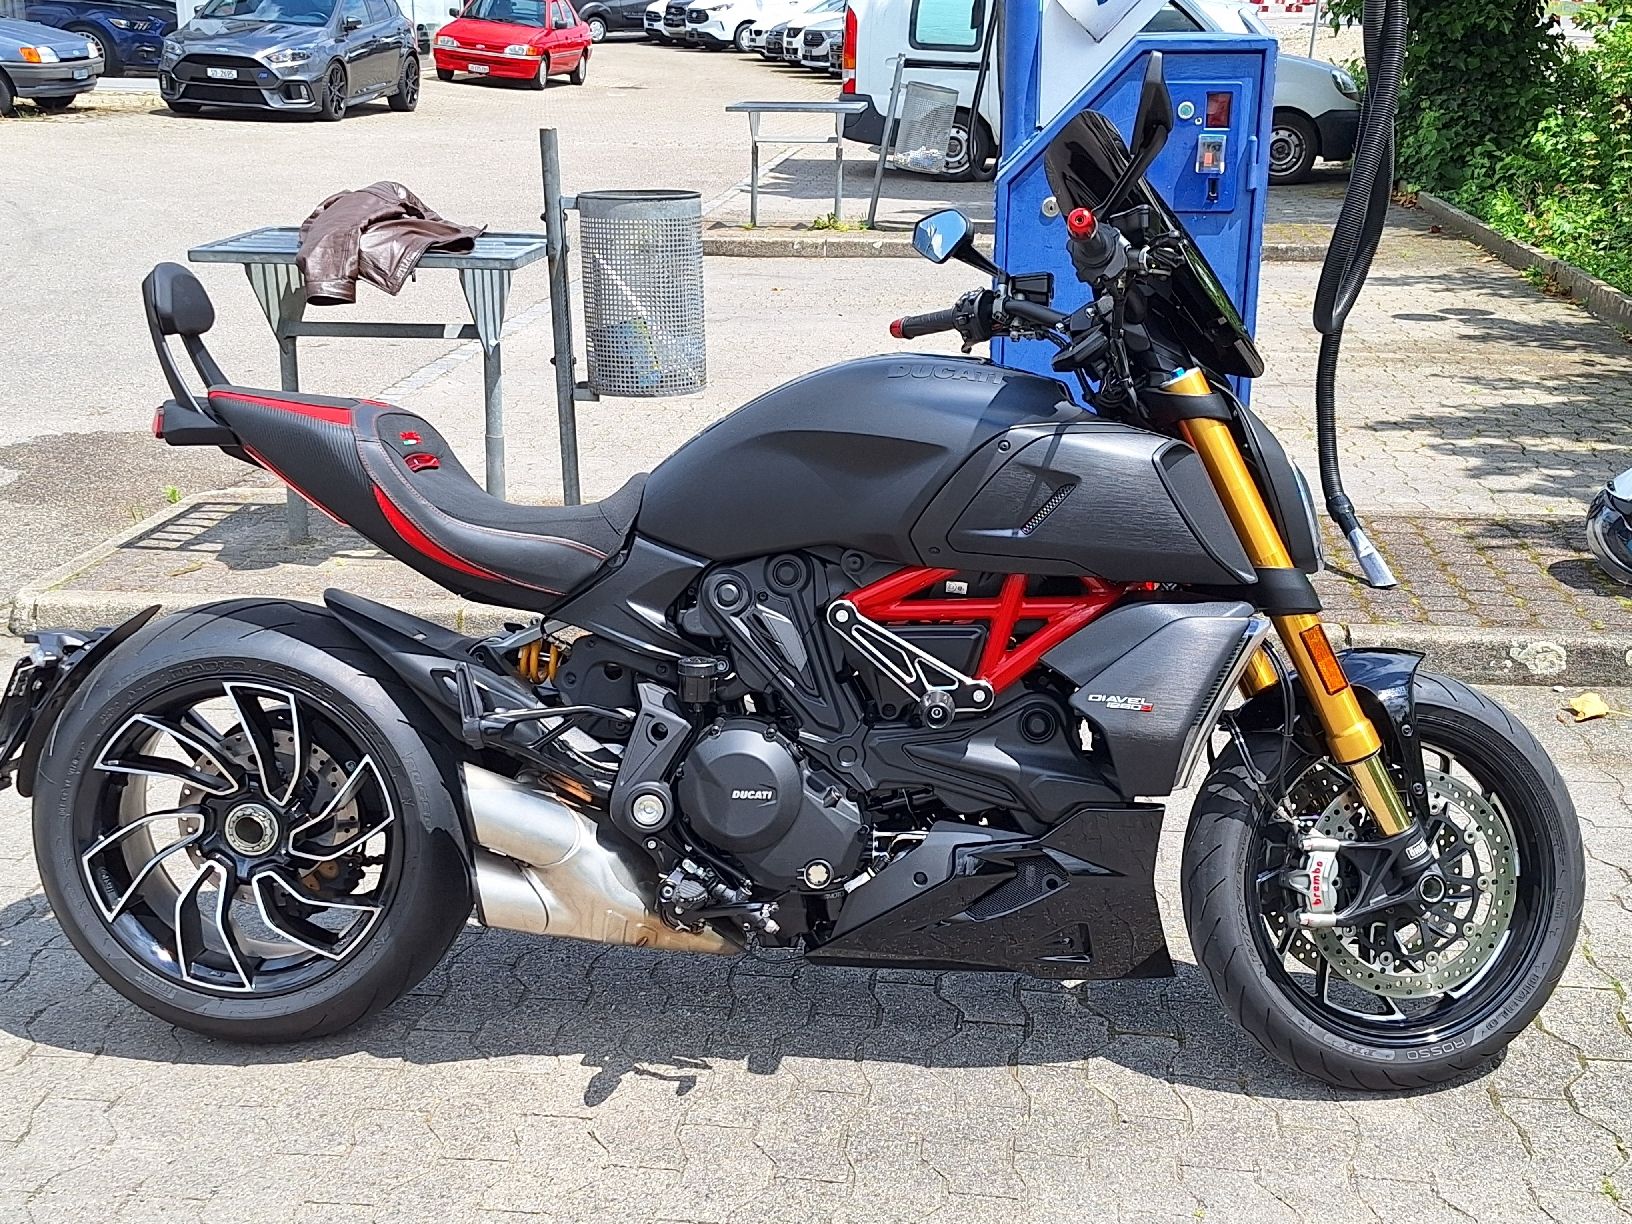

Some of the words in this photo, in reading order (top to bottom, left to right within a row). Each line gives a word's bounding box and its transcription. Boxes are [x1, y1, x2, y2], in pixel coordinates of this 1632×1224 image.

[887, 363, 1005, 384] DUCATI
[1088, 694, 1153, 706] DIAVEL
[731, 790, 773, 800] DUCATI
[1311, 861, 1323, 906] brembo
[1406, 1038, 1467, 1060] ROSSO
